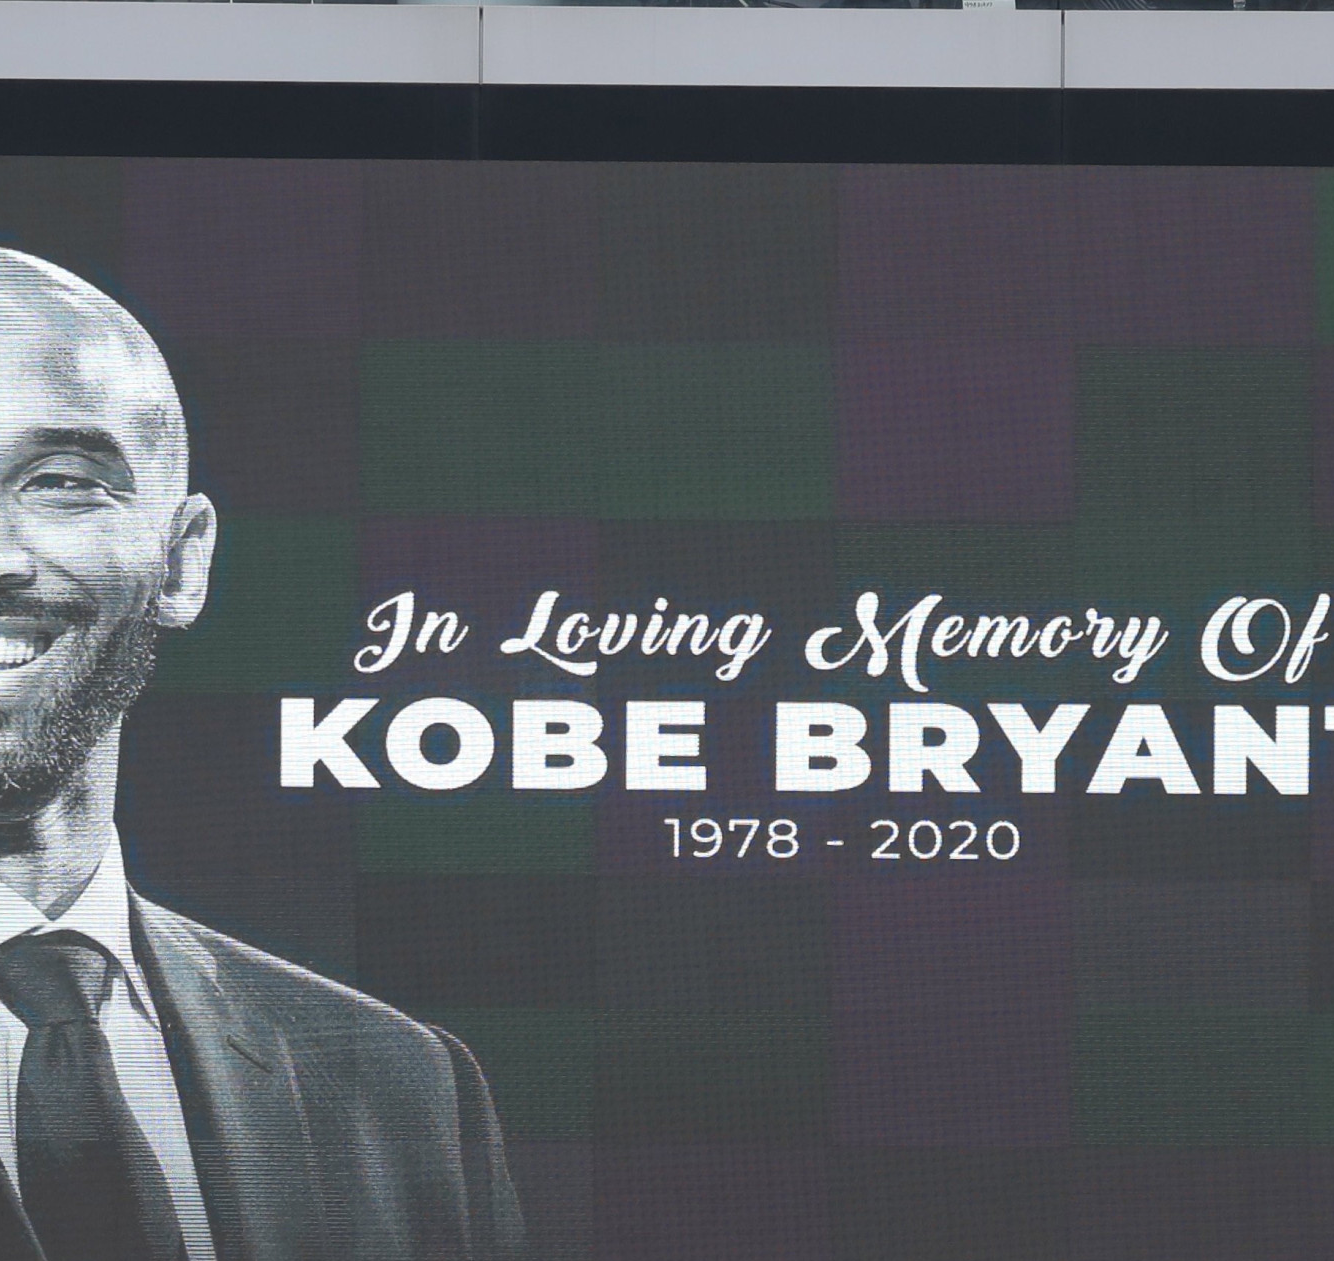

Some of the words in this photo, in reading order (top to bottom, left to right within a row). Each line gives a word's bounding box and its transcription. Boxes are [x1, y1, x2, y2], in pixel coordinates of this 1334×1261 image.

[353, 590, 469, 674] In
[499, 590, 772, 682] Loving
[804, 591, 1169, 695] Memory
[1200, 593, 1331, 684] Of
[280, 696, 707, 791] KOBE
[663, 818, 800, 859] 1978
[870, 819, 1020, 860] 2020
